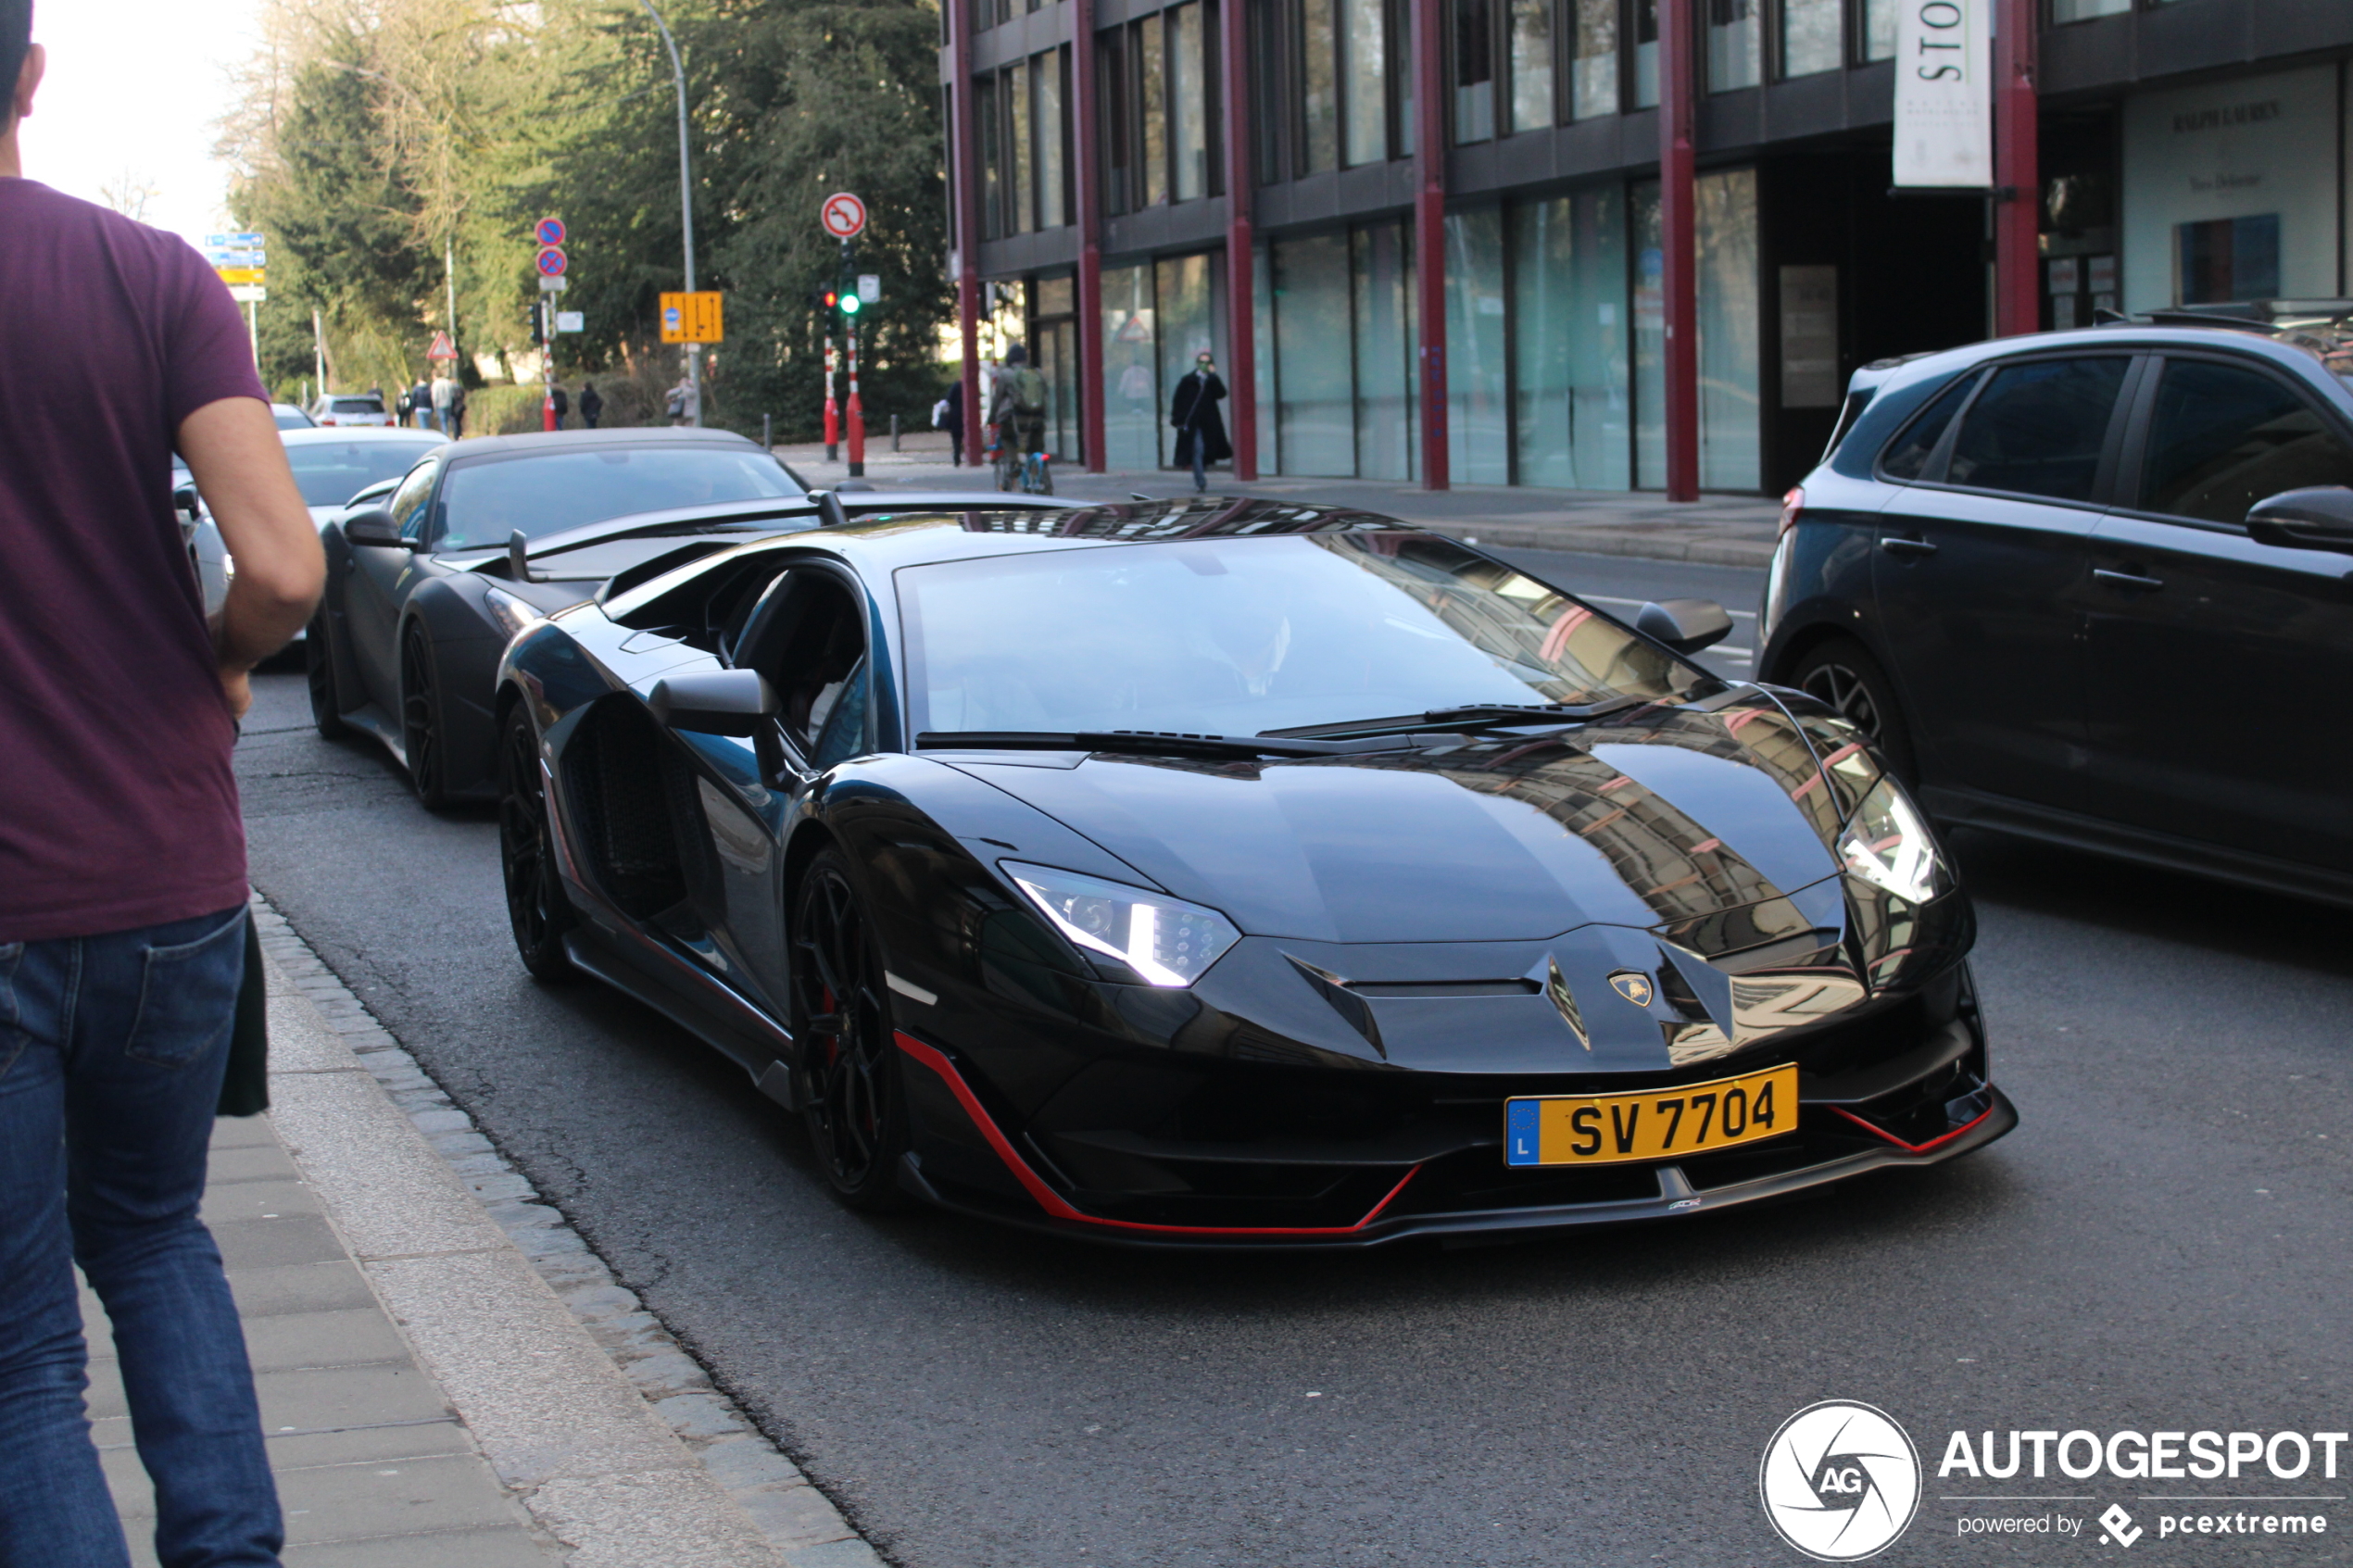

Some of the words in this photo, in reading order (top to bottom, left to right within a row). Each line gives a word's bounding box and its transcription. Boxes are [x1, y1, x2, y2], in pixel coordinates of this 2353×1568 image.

[1918, 1, 1962, 82] STO
[2173, 109, 2220, 132] RALPH
[2222, 98, 2280, 125] LAUREN
[1570, 1103, 1640, 1156] SV
[1656, 1079, 1774, 1149] 7704
[1516, 1137, 1529, 1155] L
